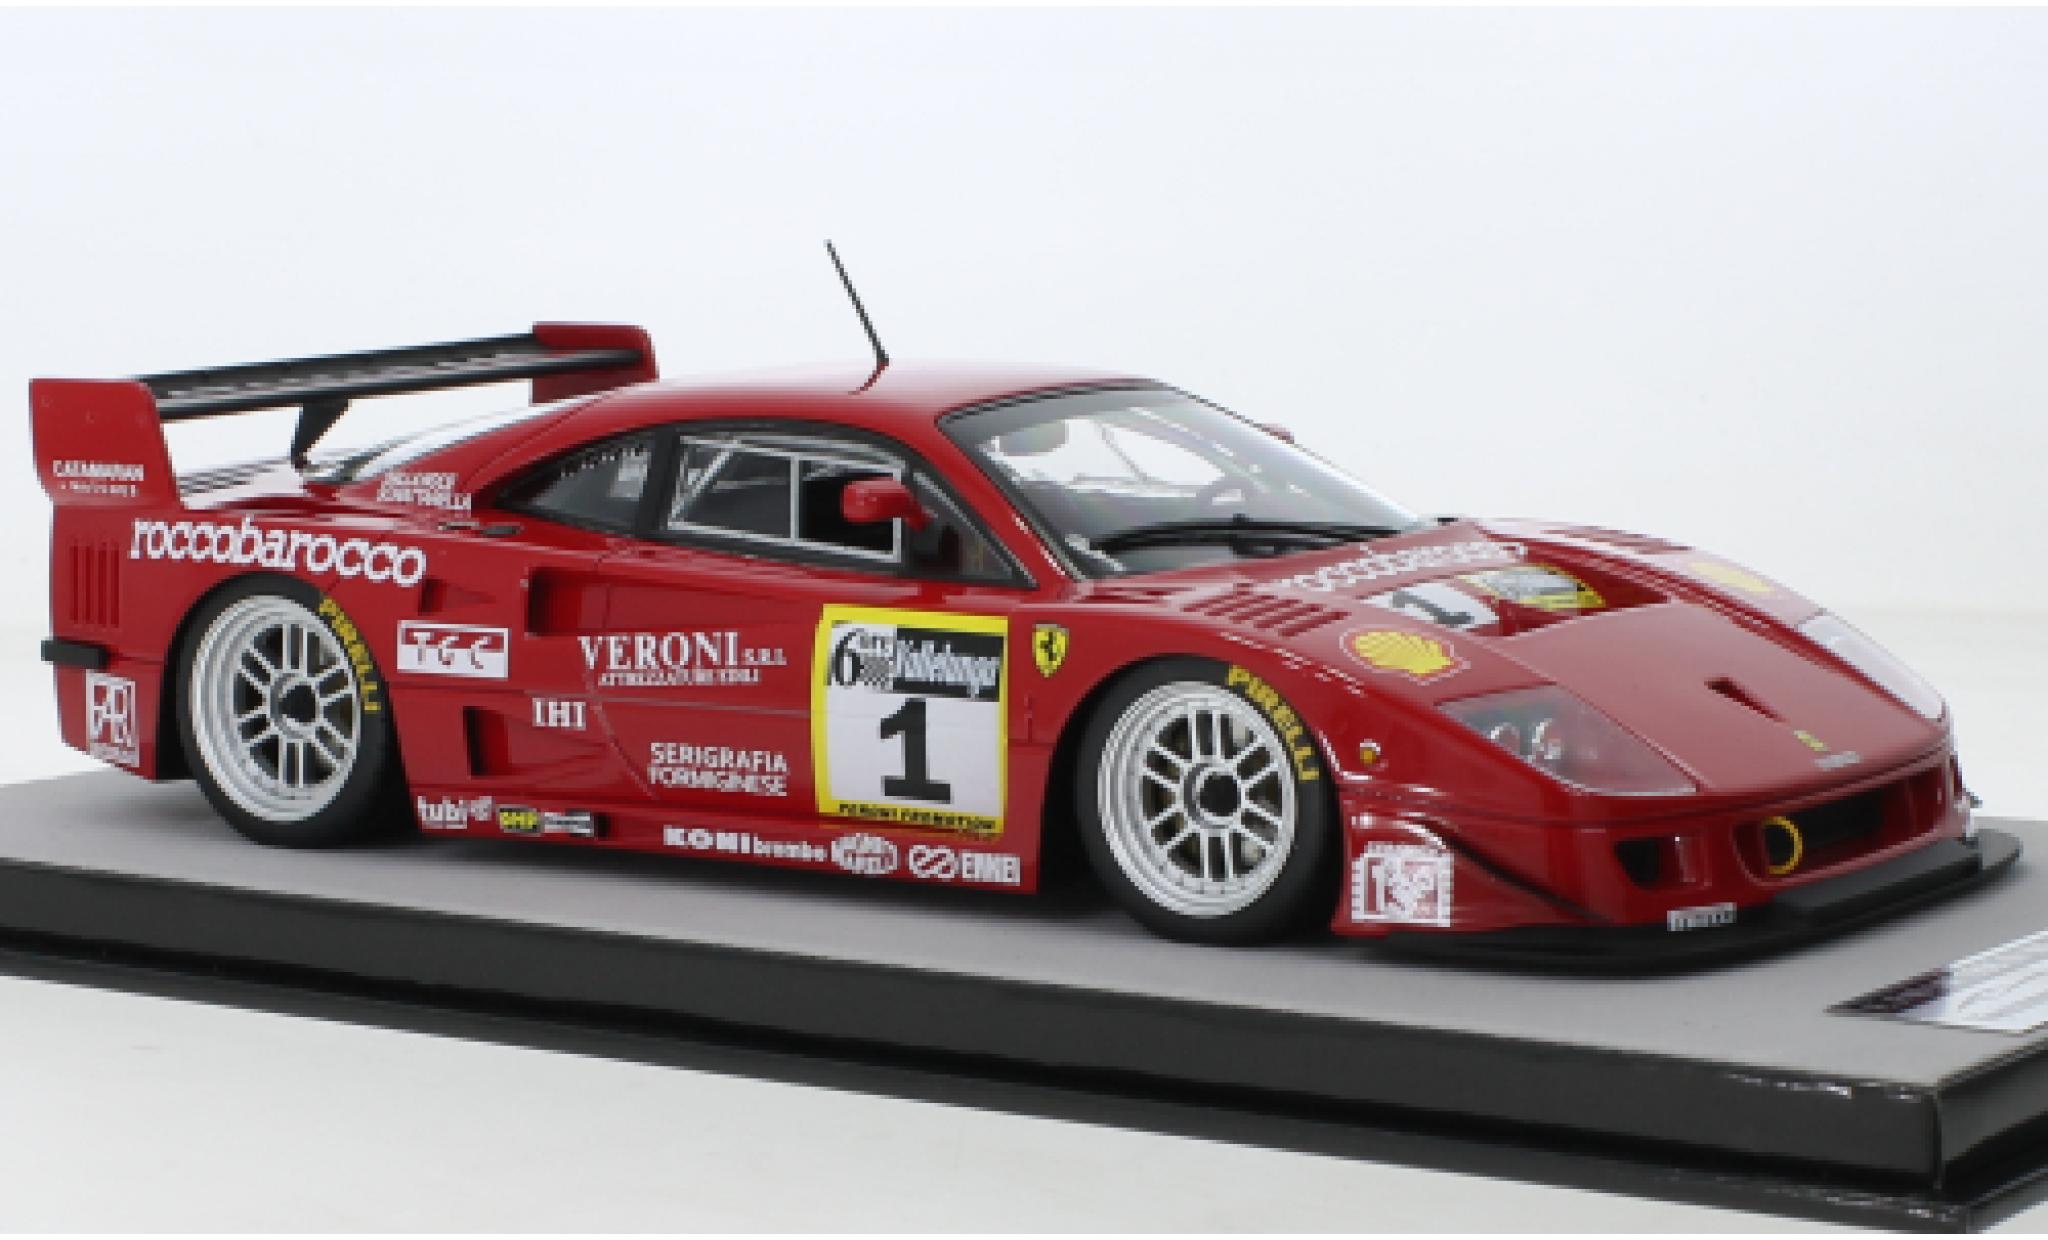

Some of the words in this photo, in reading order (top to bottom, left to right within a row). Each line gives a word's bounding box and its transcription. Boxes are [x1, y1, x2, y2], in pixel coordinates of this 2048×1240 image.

[129, 515, 427, 588] roccobarocco
[1391, 587, 1475, 629] 1
[577, 632, 738, 669] VERONI
[834, 629, 861, 687] 6
[1226, 664, 1320, 783] PIRELLI
[650, 742, 788, 772] SERIGRAFIA
[879, 697, 952, 804] 1
[663, 825, 751, 854] KONI
